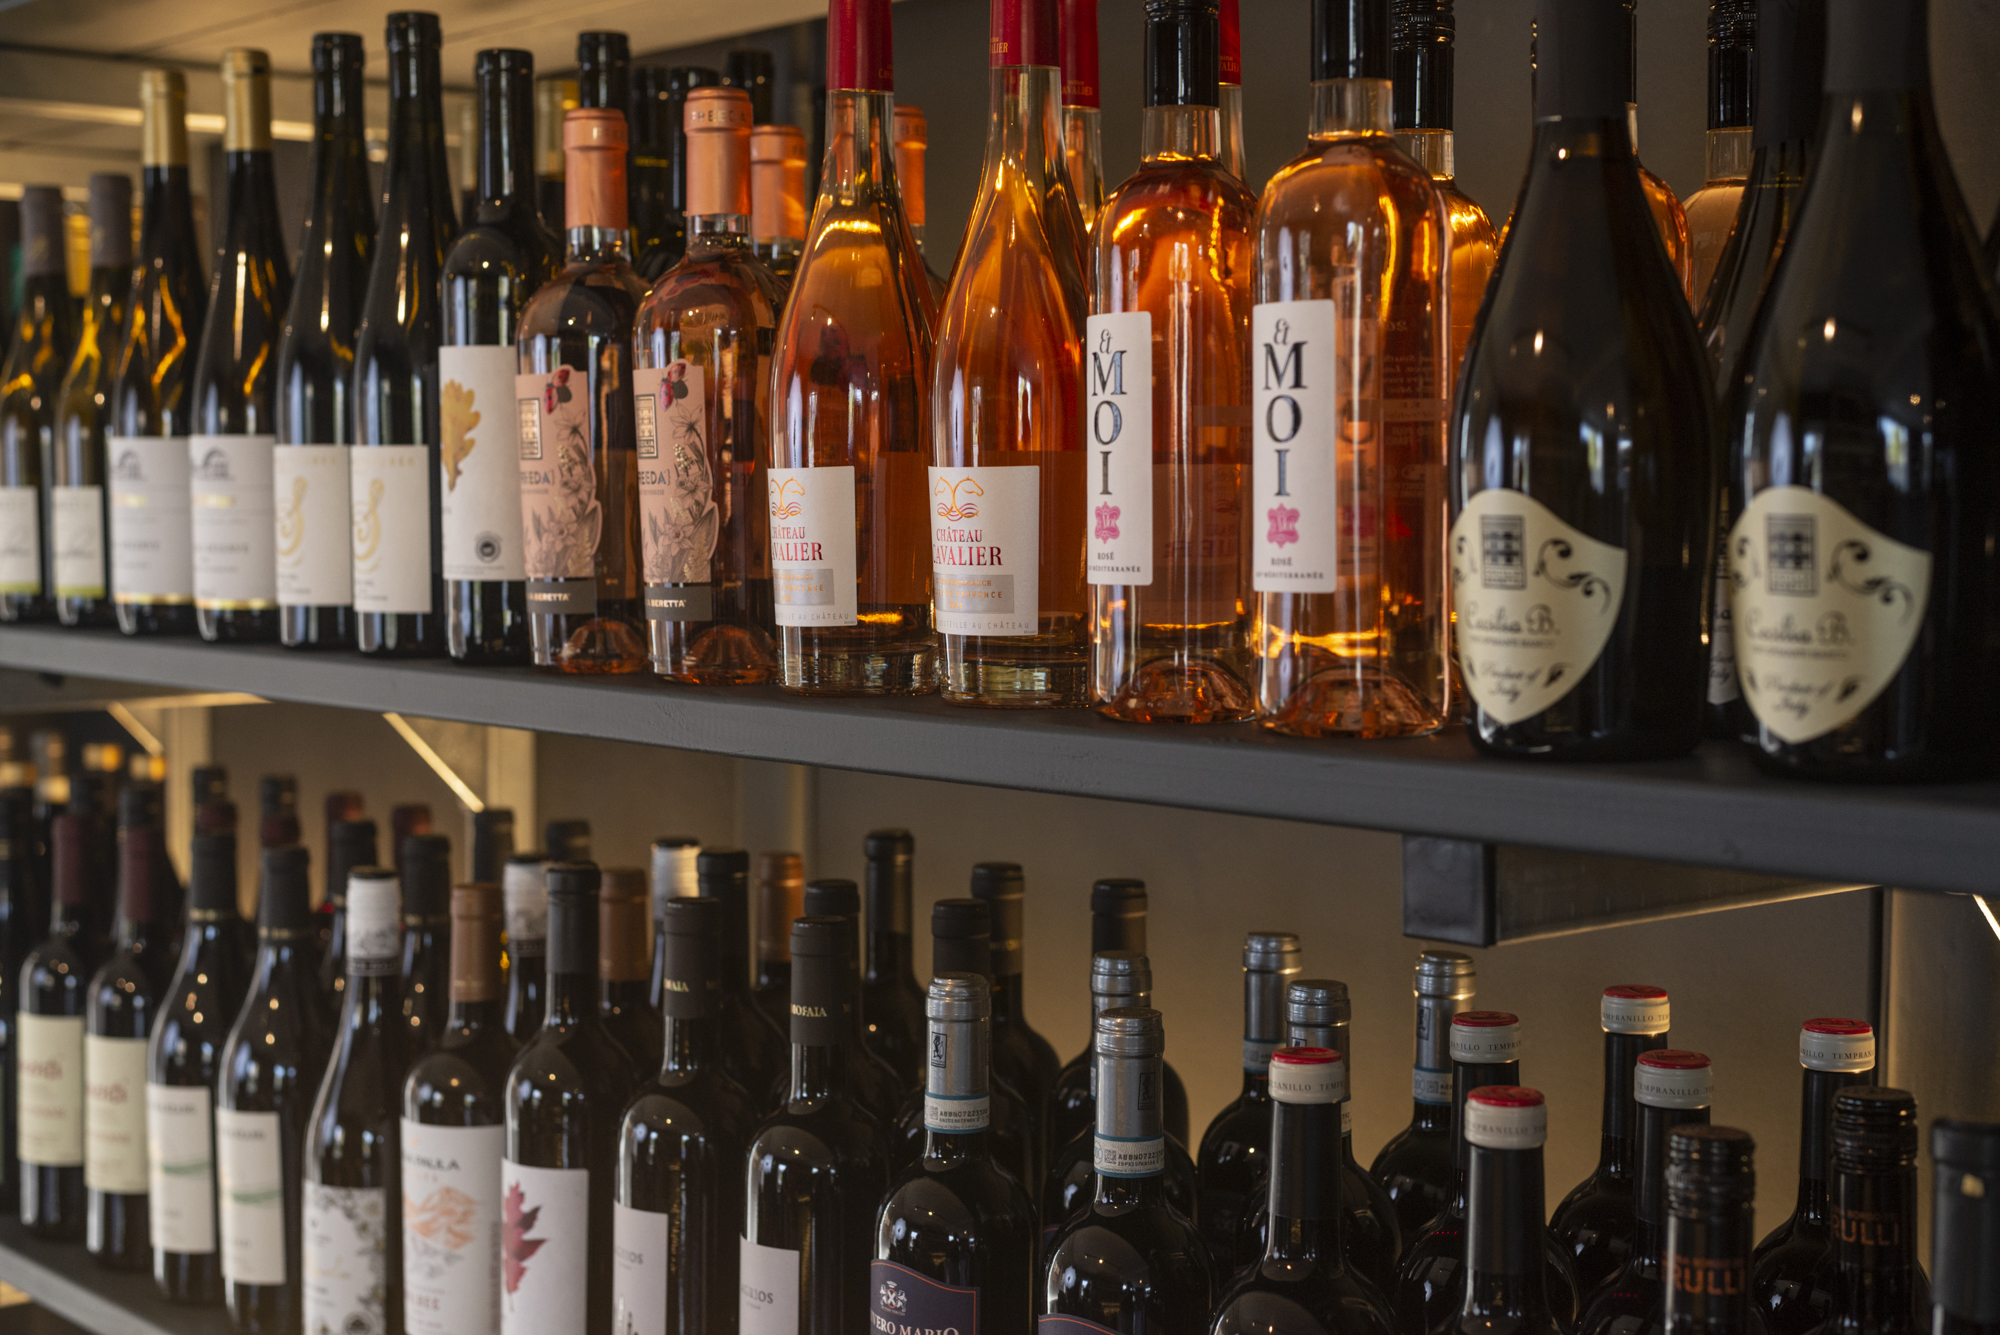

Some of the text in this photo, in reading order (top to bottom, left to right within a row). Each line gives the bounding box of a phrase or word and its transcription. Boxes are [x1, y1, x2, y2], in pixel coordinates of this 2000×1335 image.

[936, 526, 983, 543] CHÂTEAU
[1097, 552, 1115, 560] ROSÉ
[956, 591, 1003, 599] PROVENCE
[987, 620, 1030, 630] CHÂTEAU
